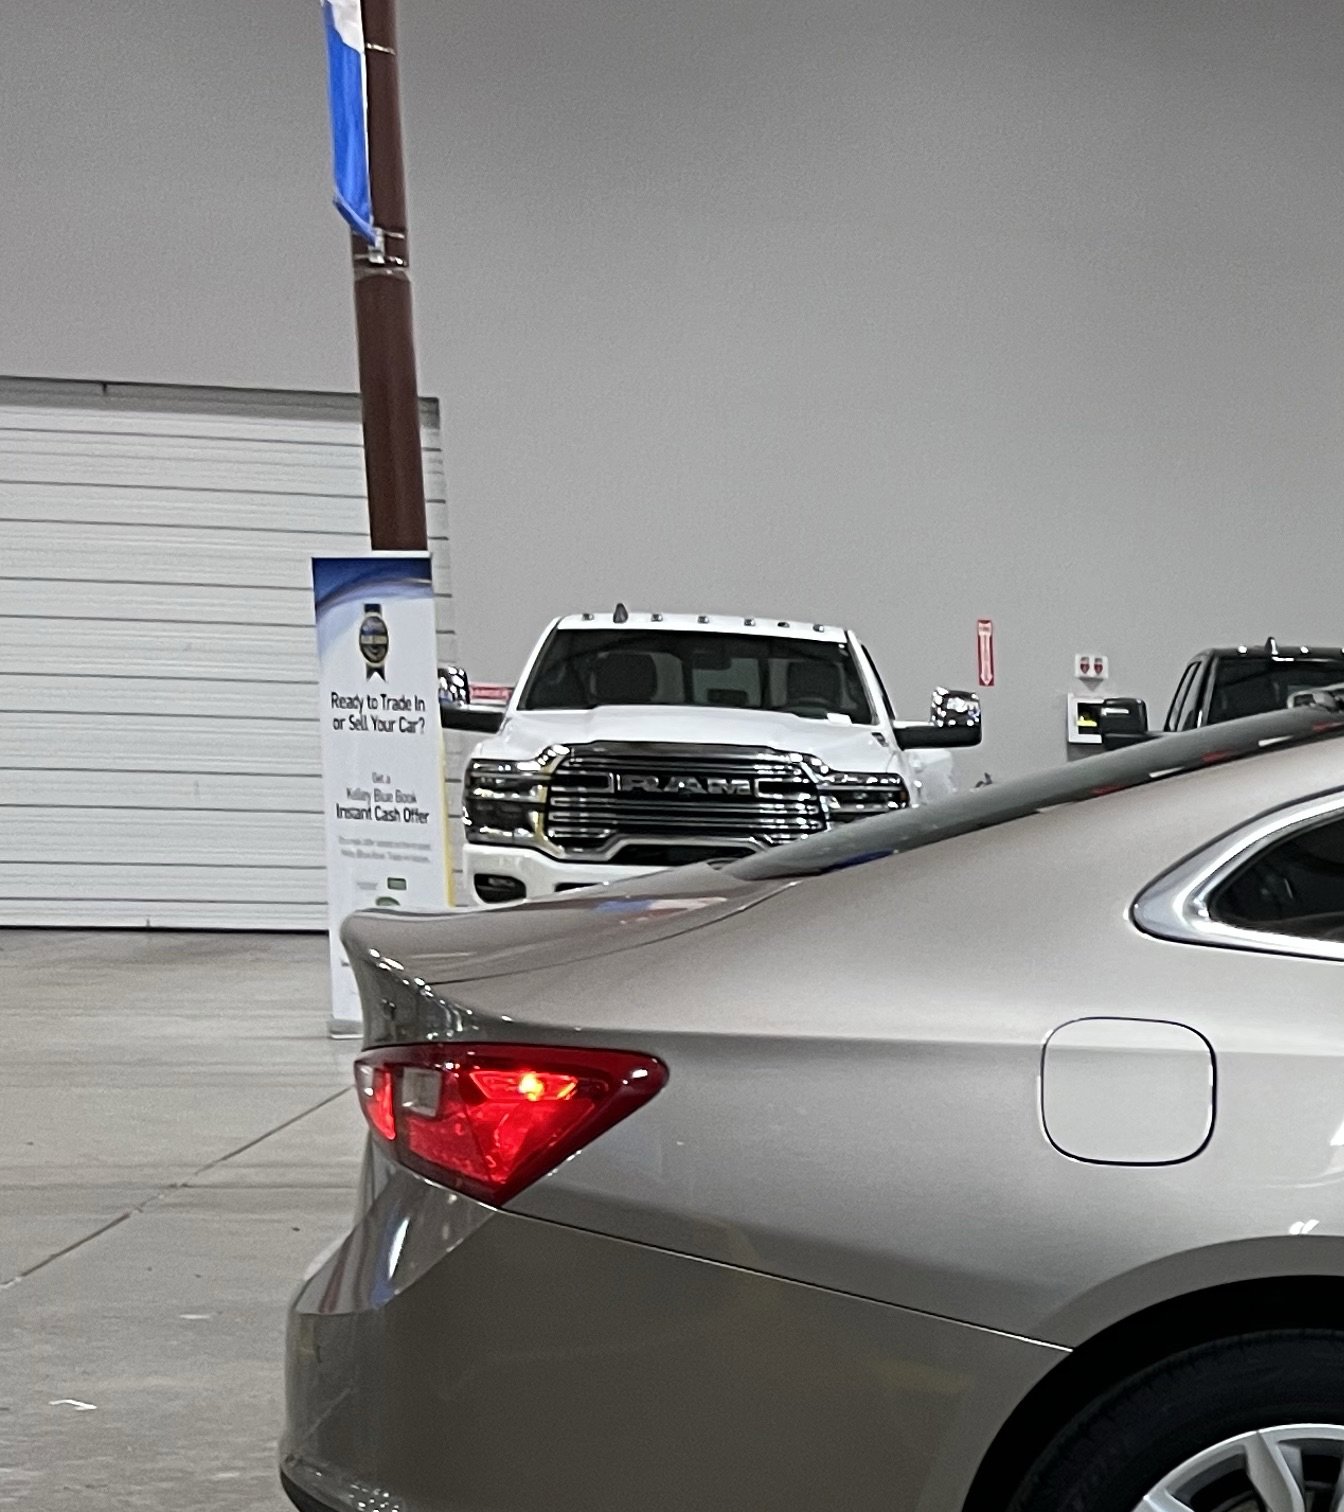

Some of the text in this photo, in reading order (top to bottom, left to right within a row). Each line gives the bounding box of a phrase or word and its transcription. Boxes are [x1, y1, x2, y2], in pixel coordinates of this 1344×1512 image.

[331, 691, 426, 714] Ready to Trade In
[333, 713, 425, 735] or Sell Your Car?
[373, 788, 393, 802] Blue
[395, 789, 417, 803] Book
[621, 773, 752, 796] RAM
[336, 803, 429, 824] Instant Cash Offer
